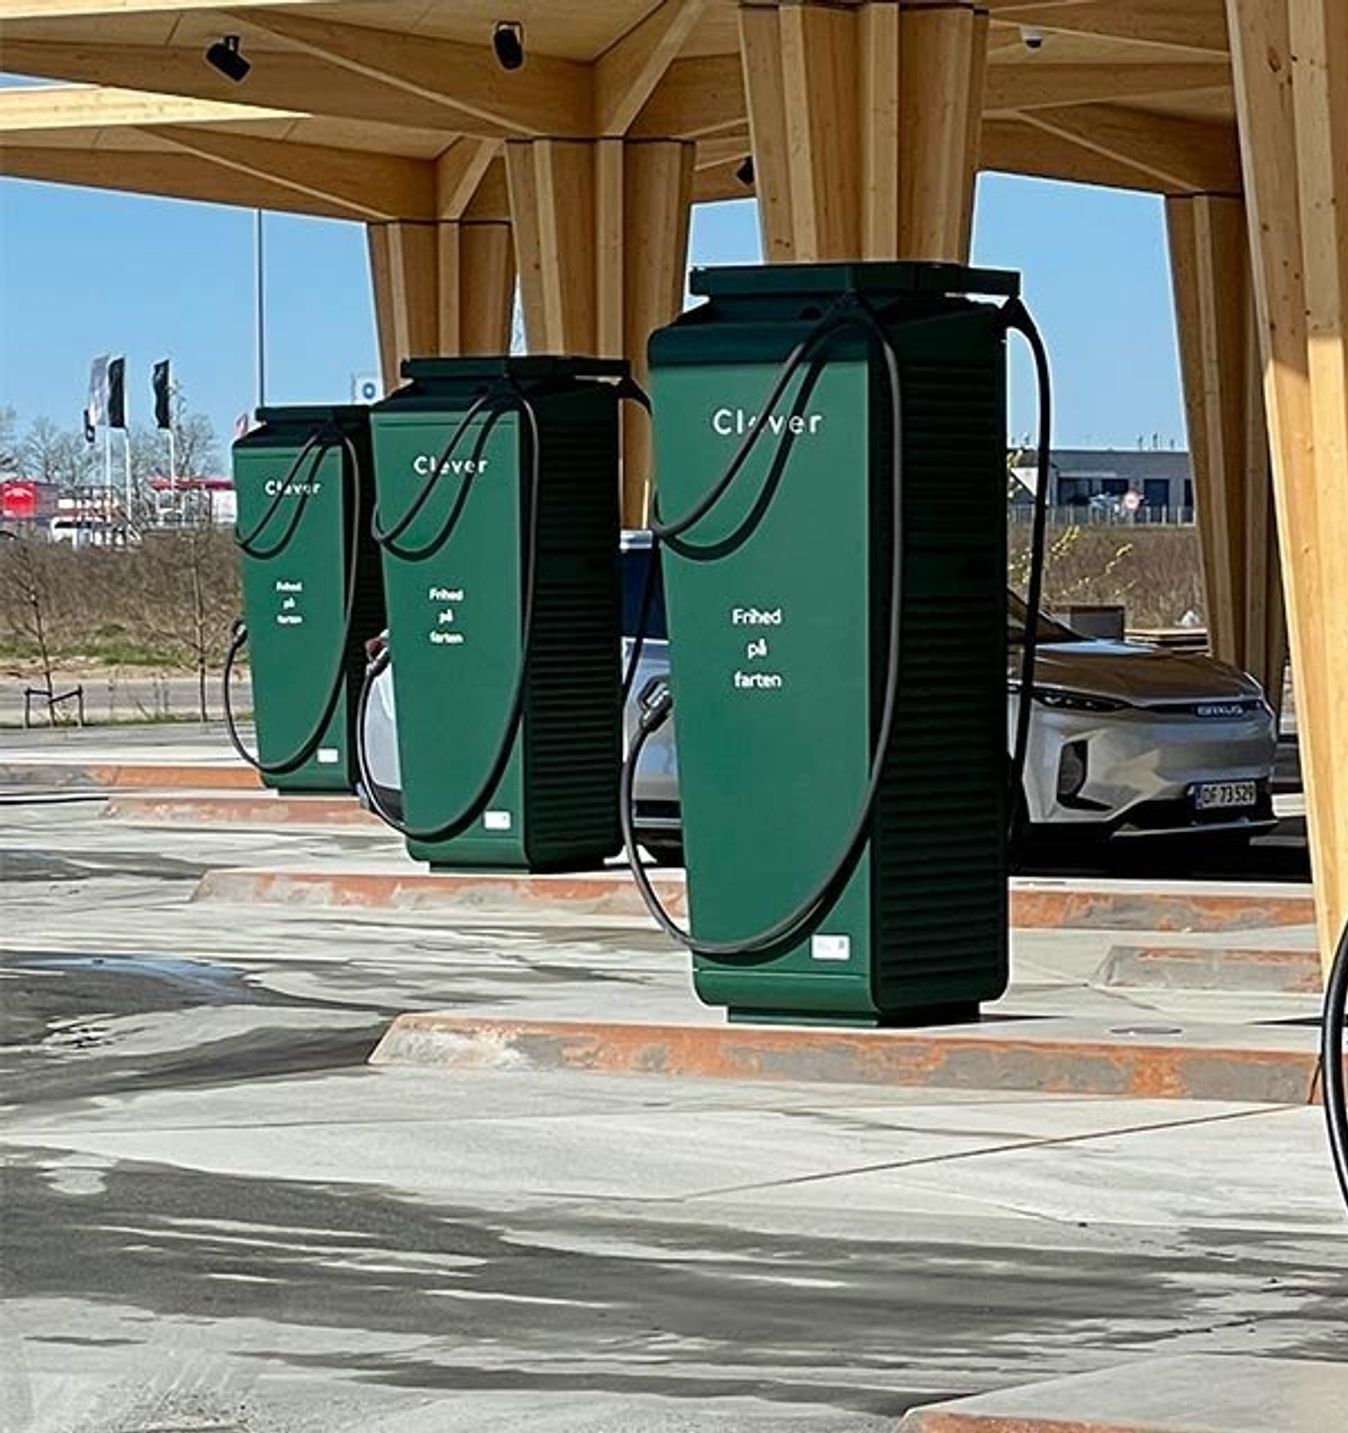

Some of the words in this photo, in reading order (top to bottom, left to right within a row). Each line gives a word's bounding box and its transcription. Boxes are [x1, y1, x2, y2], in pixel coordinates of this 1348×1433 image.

[732, 608, 782, 625] Frihed
[747, 638, 767, 659] på
[734, 671, 782, 688] farten
